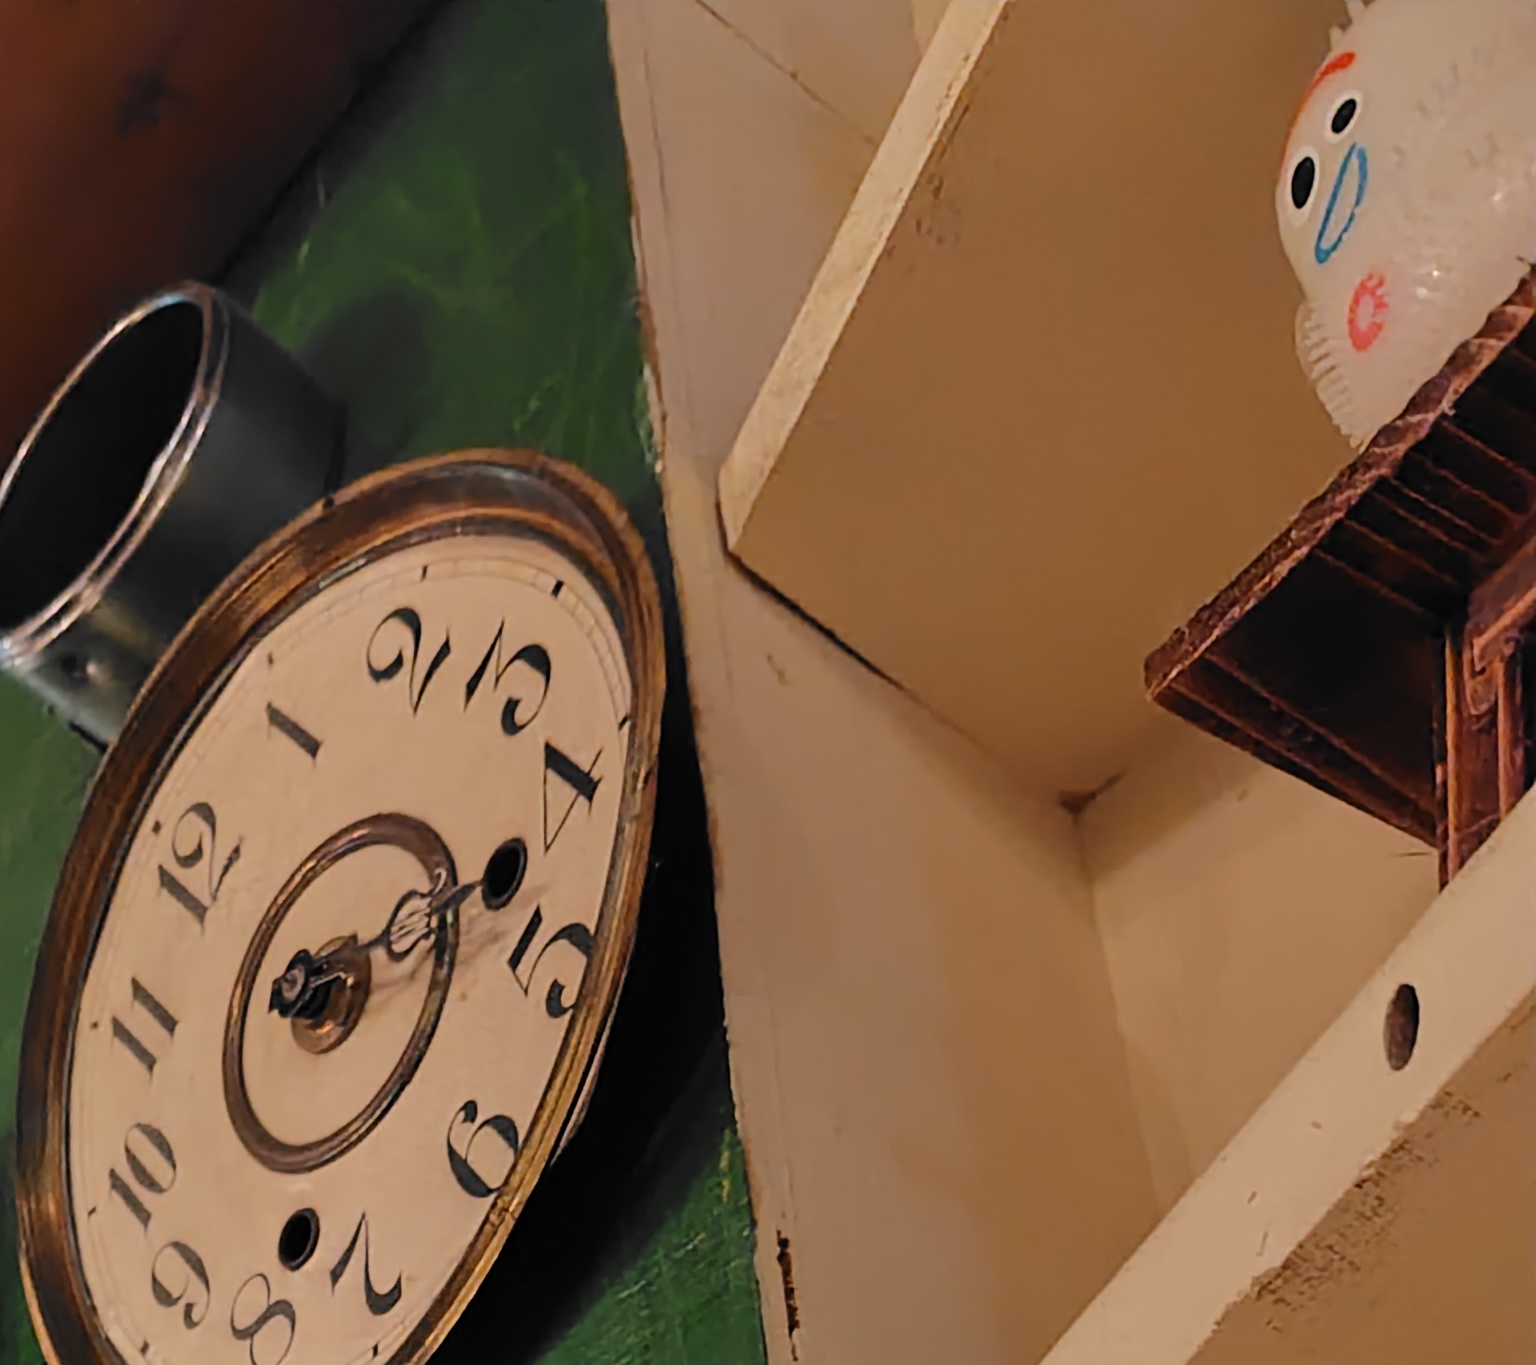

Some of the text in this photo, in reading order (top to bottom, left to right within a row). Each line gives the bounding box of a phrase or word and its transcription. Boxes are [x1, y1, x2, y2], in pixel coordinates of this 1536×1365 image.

[366, 606, 451, 717] 2
[464, 617, 552, 737] 3
[265, 701, 324, 768] 1
[542, 740, 605, 858] 4
[157, 802, 244, 935] 12
[507, 904, 596, 1019] 5
[111, 976, 179, 1082] 11
[108, 1123, 177, 1238] 10
[446, 1100, 520, 1198] 6
[151, 1241, 211, 1329] 9
[329, 1209, 402, 1316] 7
